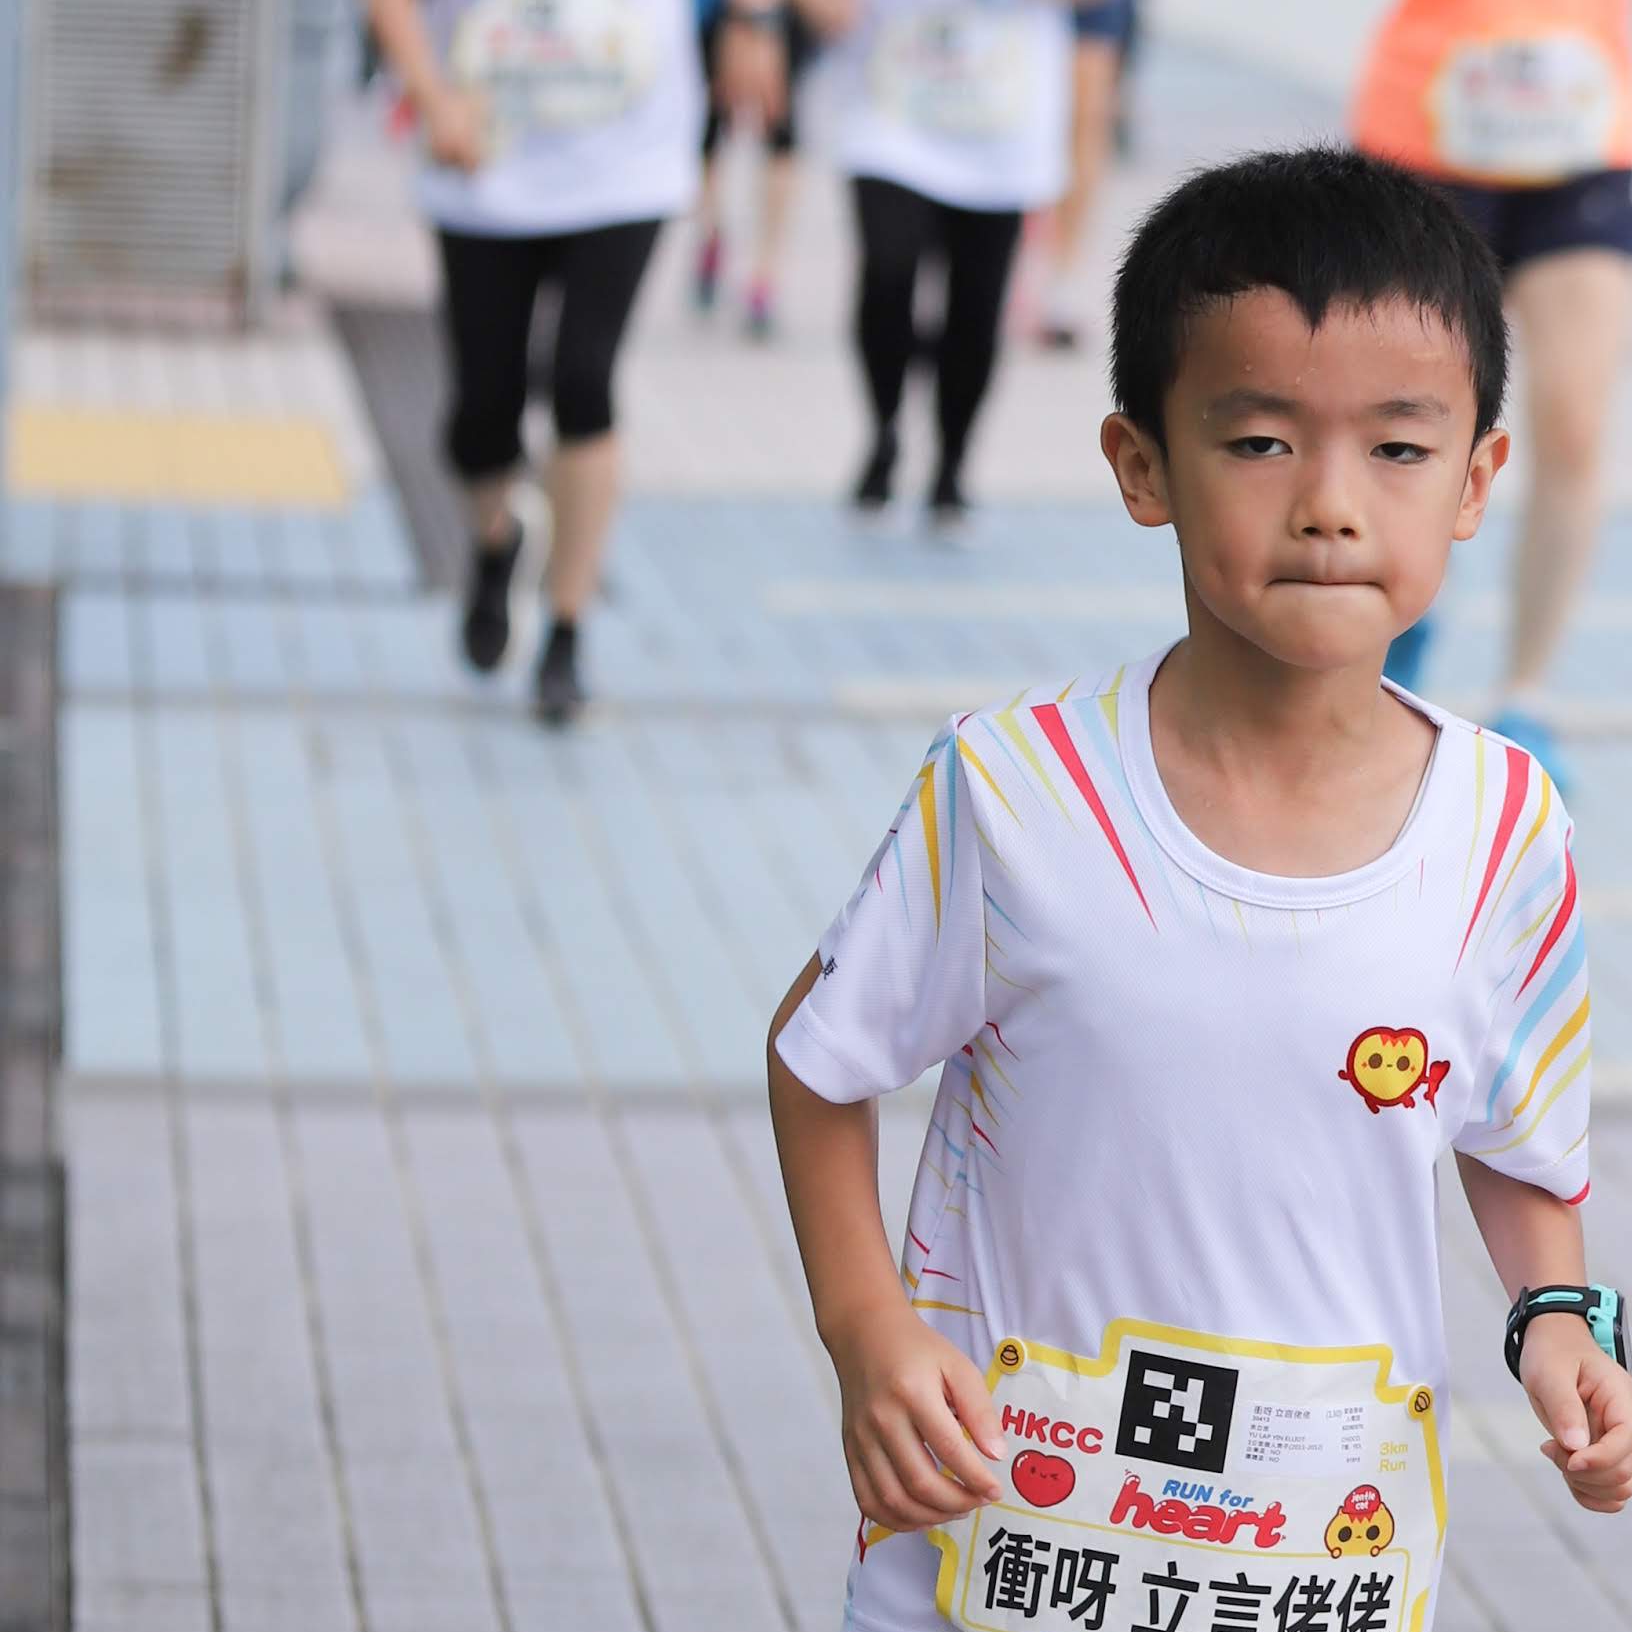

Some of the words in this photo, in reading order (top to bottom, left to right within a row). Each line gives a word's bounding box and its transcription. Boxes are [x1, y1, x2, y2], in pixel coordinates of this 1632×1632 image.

[1001, 1404, 1104, 1454] HKCC
[1380, 1442, 1409, 1456] 3km
[1380, 1458, 1407, 1471] Run
[1109, 1474, 1286, 1549] heart
[1162, 1479, 1215, 1503] RUN
[1219, 1489, 1255, 1509] for
[983, 1526, 1120, 1631] 衝呀
